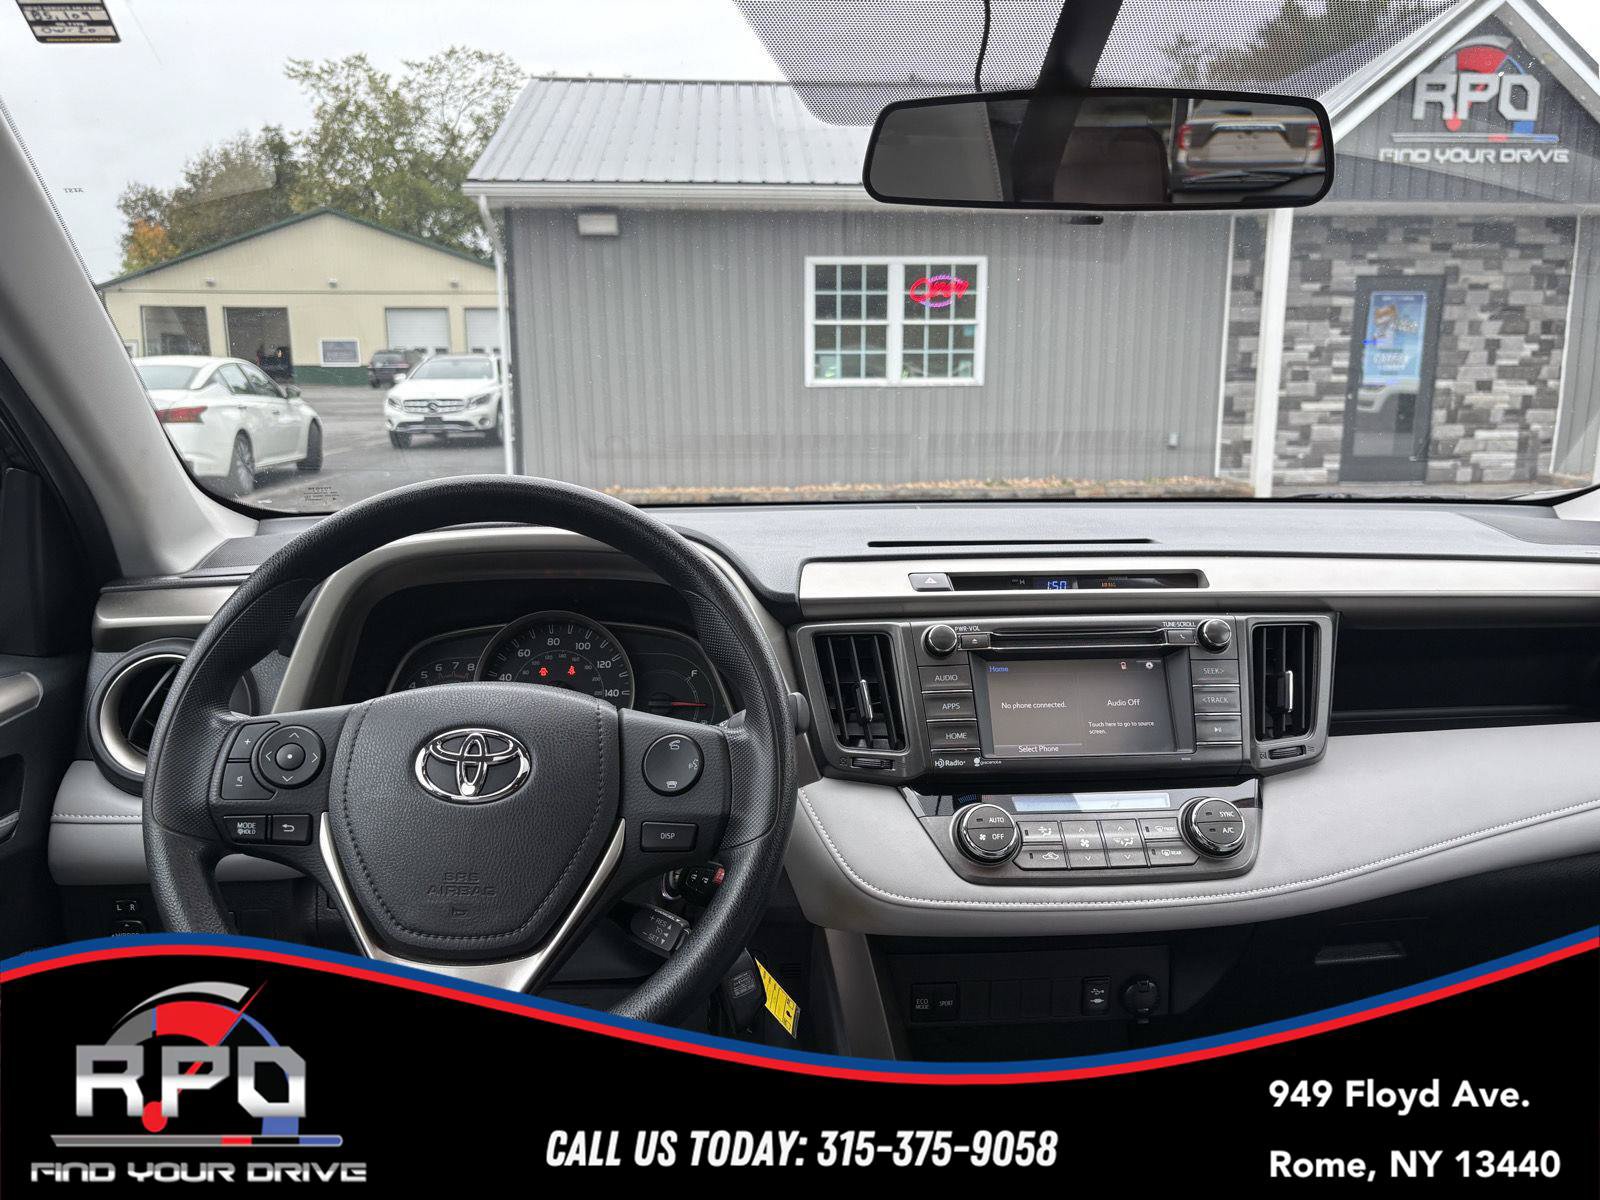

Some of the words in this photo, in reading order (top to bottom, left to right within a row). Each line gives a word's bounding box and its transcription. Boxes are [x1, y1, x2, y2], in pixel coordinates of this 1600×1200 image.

[1379, 148, 1432, 163] FIND
[1435, 148, 1495, 163] YOUR
[1501, 148, 1570, 163] DRIVE
[548, 638, 560, 646] 80
[518, 649, 530, 657] 60
[436, 664, 442, 672] 6
[452, 662, 459, 670] 7
[421, 671, 428, 679] 5
[934, 674, 958, 682] AUDIO
[1013, 702, 1032, 710] phone
[427, 885, 497, 897] AIRBAG
